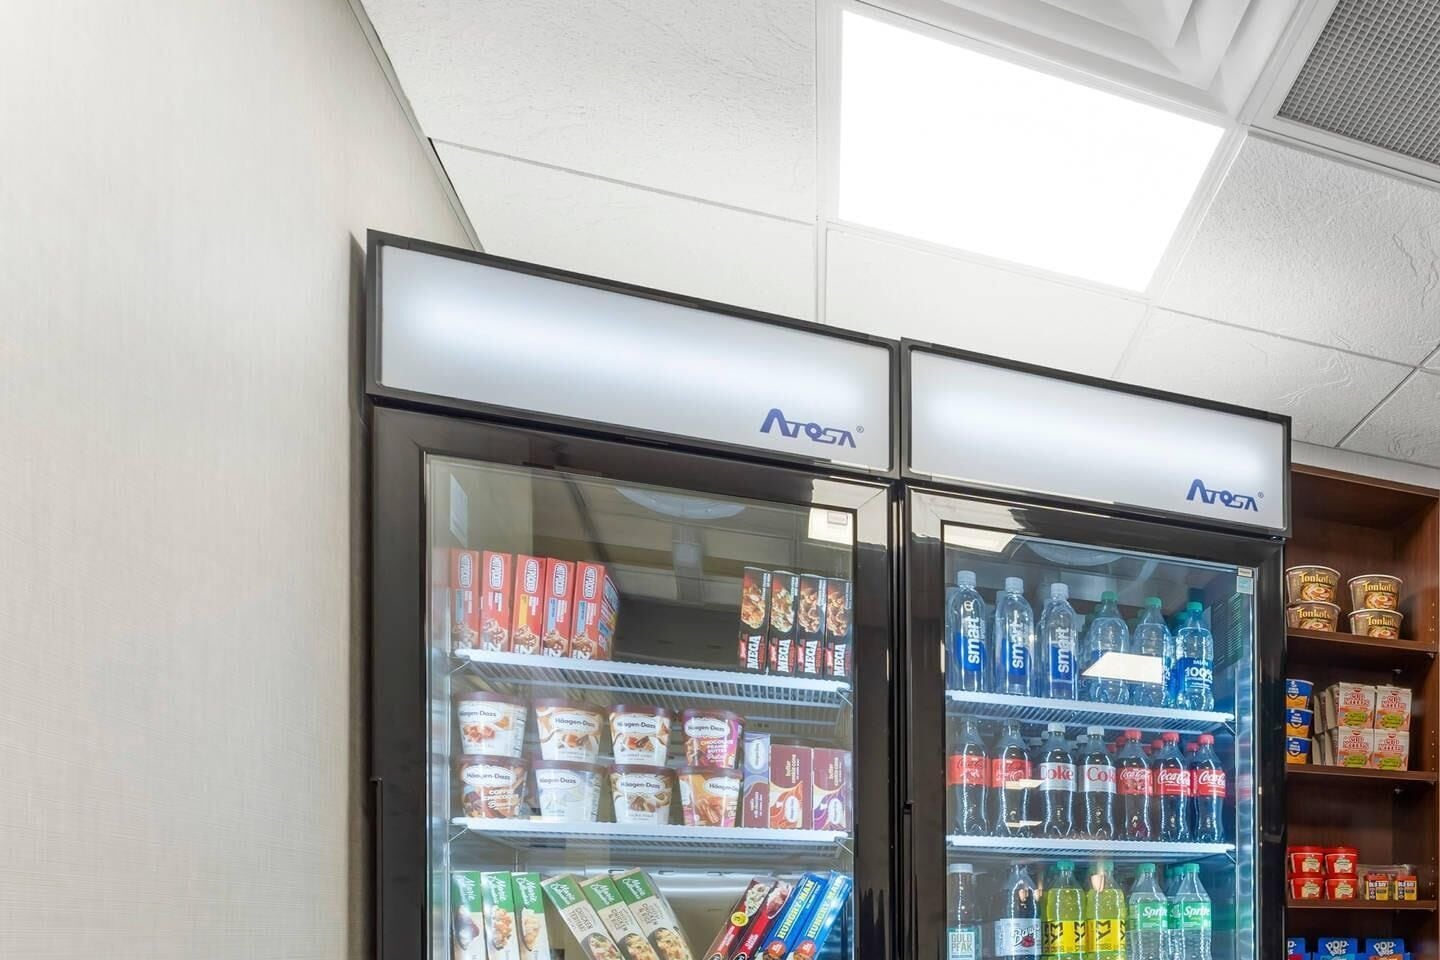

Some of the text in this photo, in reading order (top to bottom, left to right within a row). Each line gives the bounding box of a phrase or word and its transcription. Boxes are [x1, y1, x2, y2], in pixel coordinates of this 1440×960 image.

[1299, 571, 1332, 583] Tonkot
[1362, 581, 1396, 592] Tonkot
[1297, 607, 1331, 619] Tonkot
[1366, 615, 1396, 626] Tonkot
[747, 635, 761, 669] MEGA
[777, 640, 791, 672] MEGA
[967, 615, 980, 665] smart
[1010, 620, 1024, 669] smart
[1056, 626, 1069, 674] smart
[805, 640, 818, 674] MEGA
[834, 644, 846, 676] MEGA
[709, 783, 739, 791] Häagen-D
[1040, 765, 1074, 781] Coke
[777, 880, 815, 939] HUNGRY-MAN
